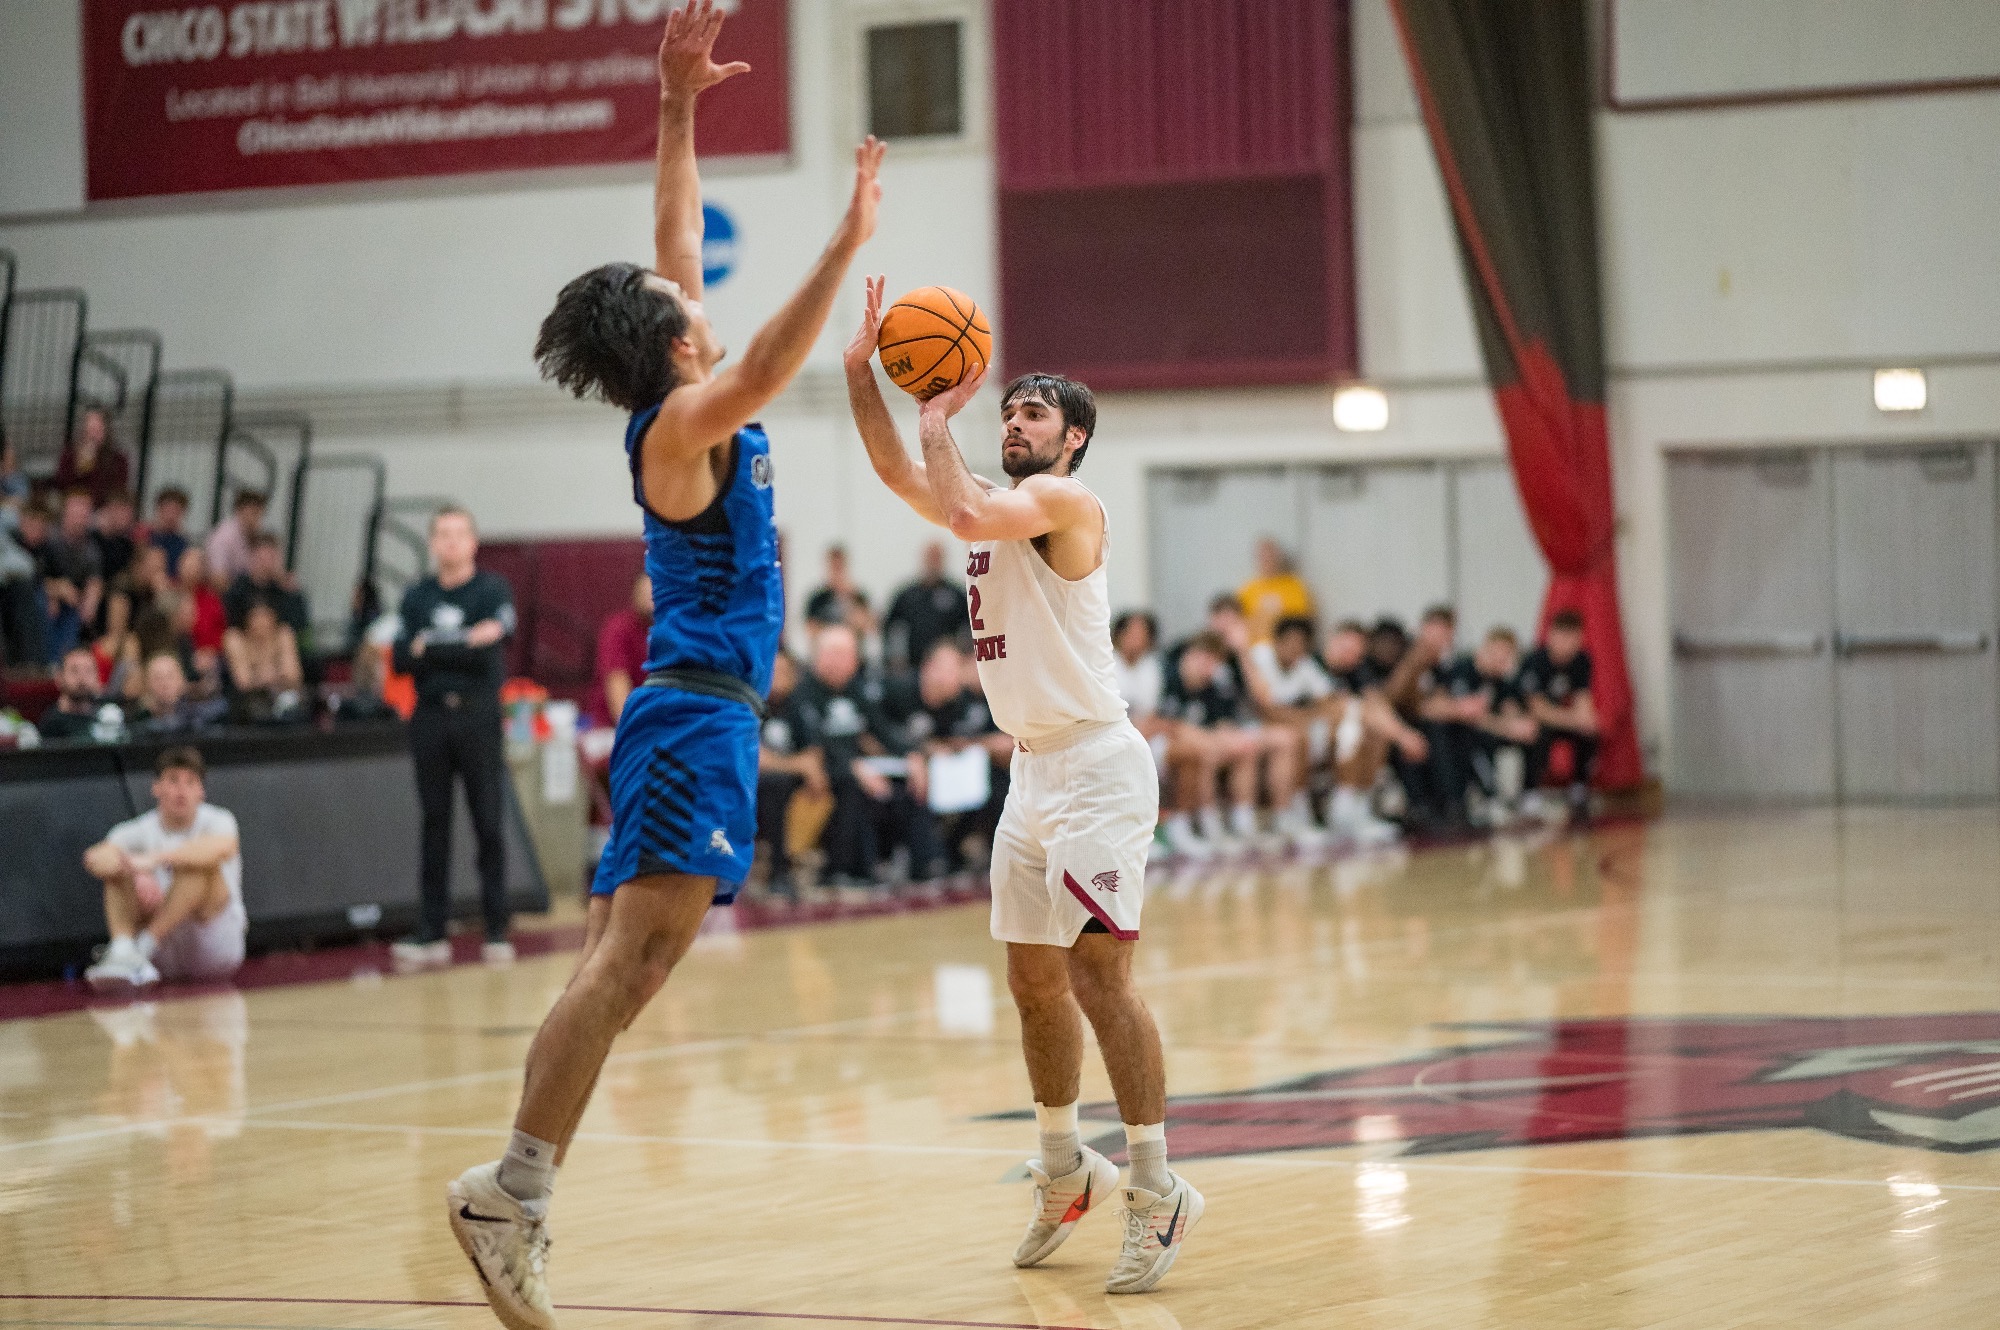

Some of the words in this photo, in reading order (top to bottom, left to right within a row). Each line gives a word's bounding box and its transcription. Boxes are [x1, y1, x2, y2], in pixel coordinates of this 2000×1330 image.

[121, 5, 226, 66] CHICO
[227, 0, 334, 57] STATE
[333, 0, 549, 46] WILDCAT
[165, 80, 260, 122] Located
[466, 62, 538, 98] Union
